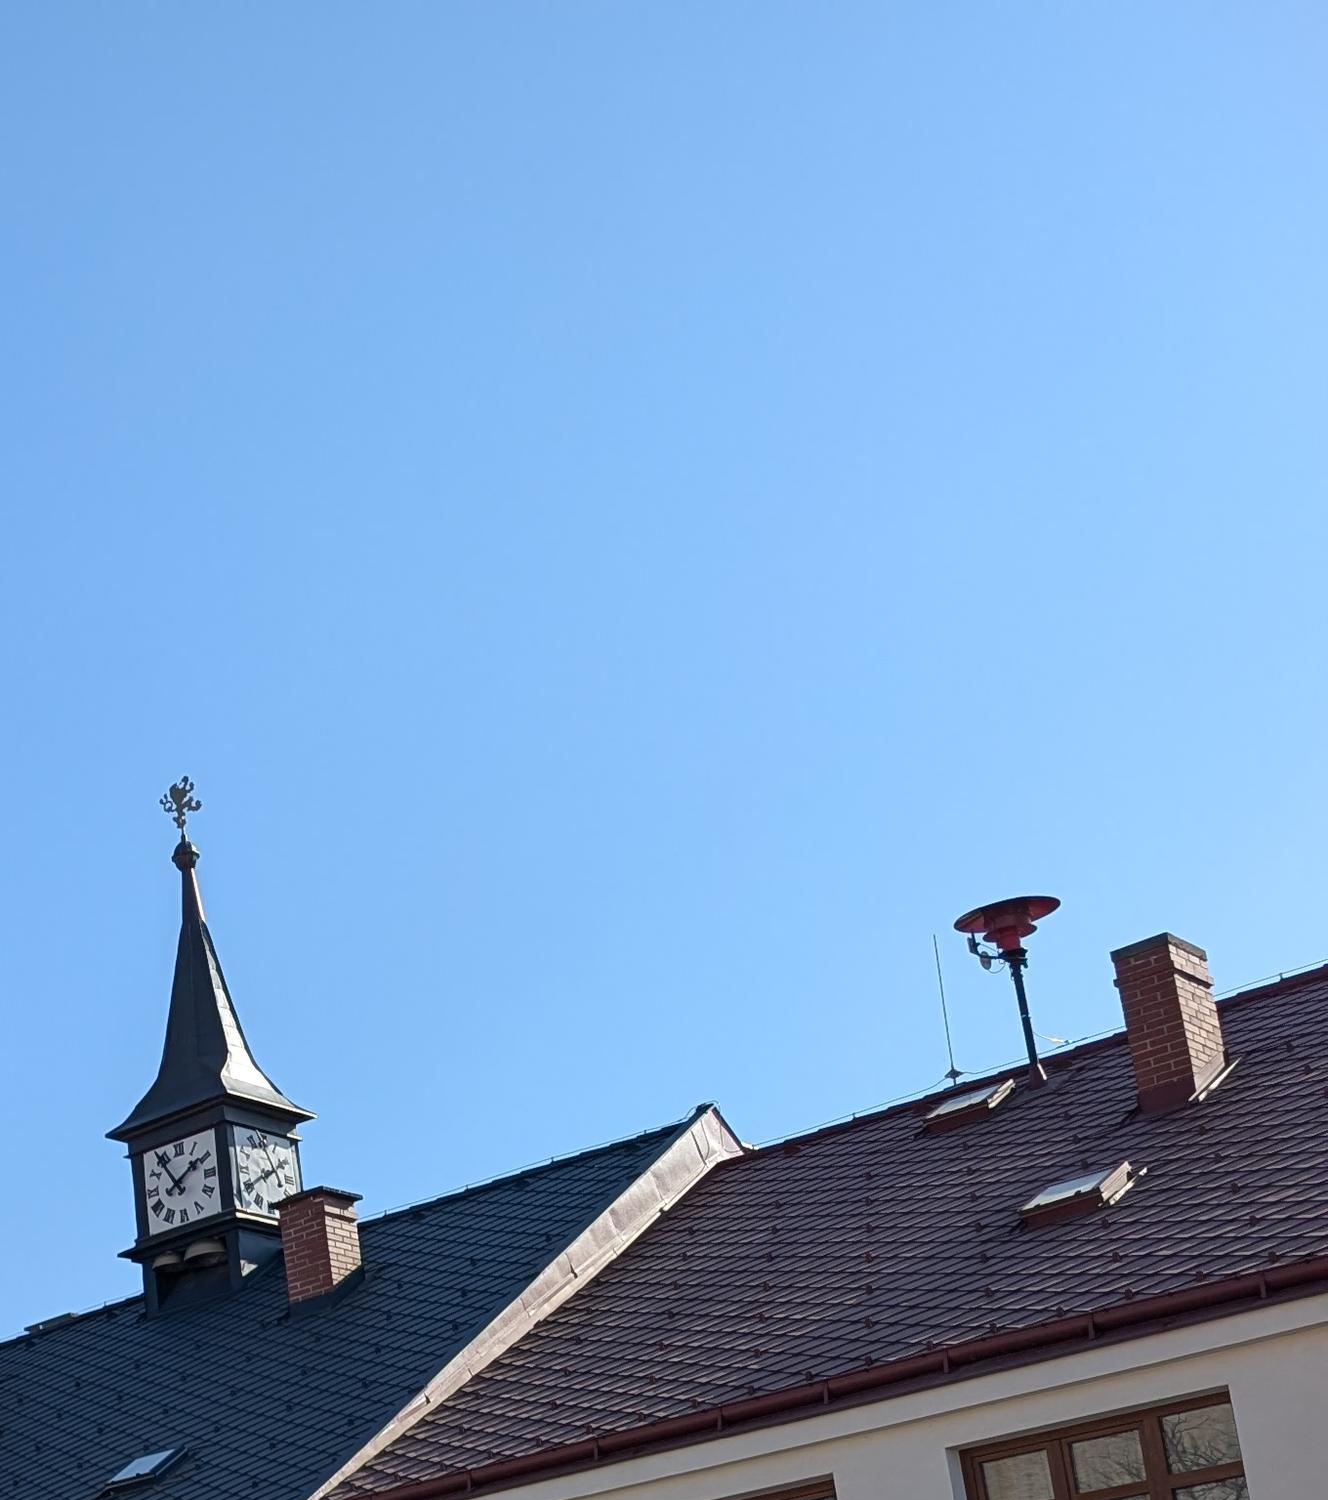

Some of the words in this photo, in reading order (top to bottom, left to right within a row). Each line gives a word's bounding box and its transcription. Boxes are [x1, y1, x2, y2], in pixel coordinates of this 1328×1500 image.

[173, 1142, 185, 1158] XII
[189, 1141, 198, 1156] I
[149, 1169, 163, 1180] X
[204, 1166, 217, 1180] III
[193, 1201, 205, 1215] V
